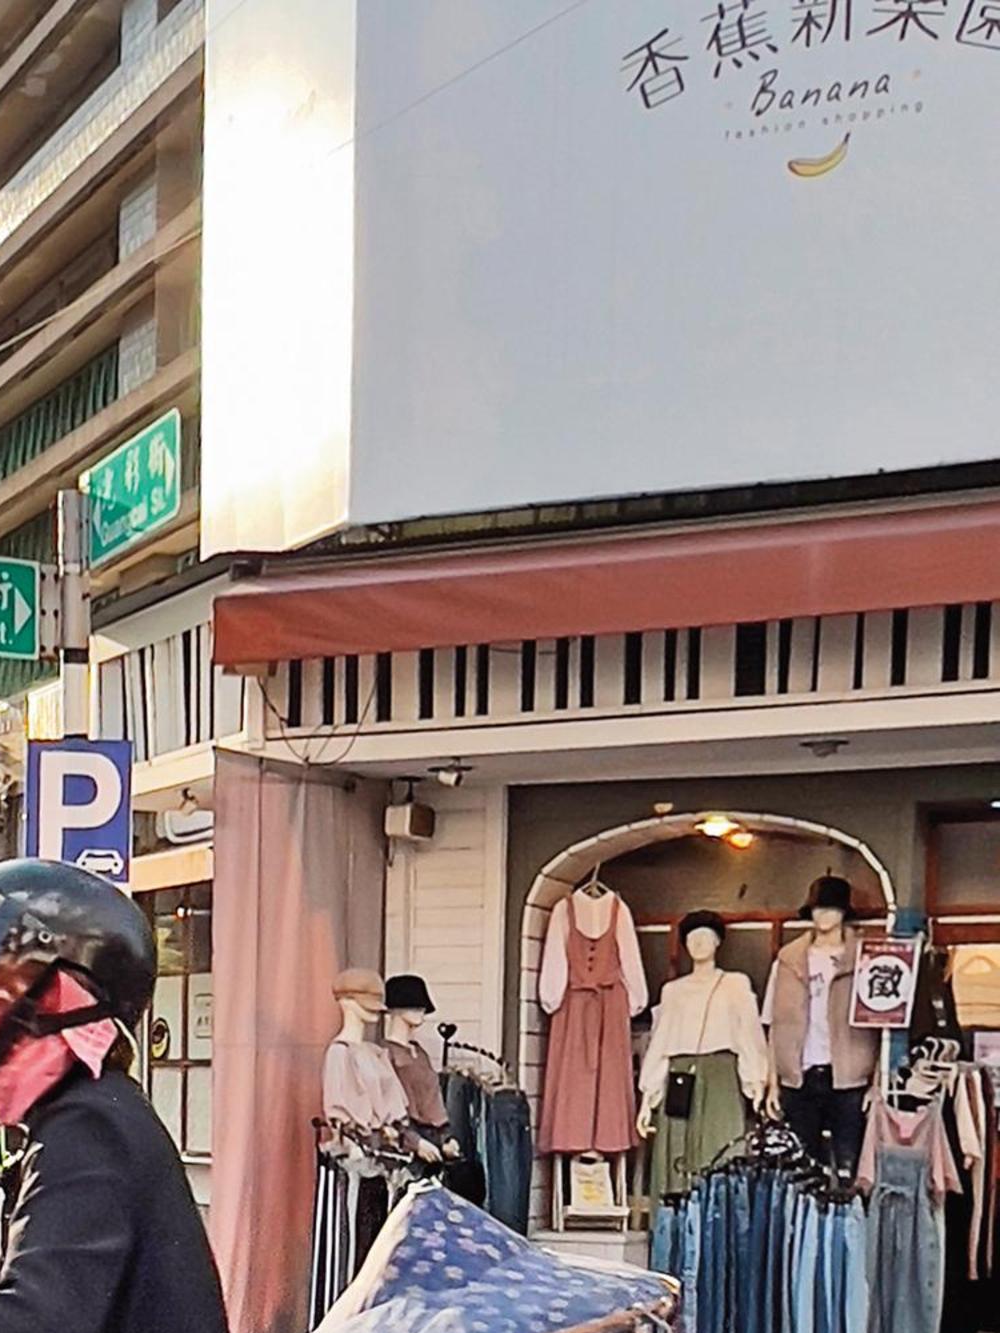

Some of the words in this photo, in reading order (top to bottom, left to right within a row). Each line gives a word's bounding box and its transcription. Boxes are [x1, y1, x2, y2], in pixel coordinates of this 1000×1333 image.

[750, 69, 890, 117] Banana
[725, 120, 806, 140] fashion
[821, 101, 924, 126] shopping
[40, 750, 122, 860] P
